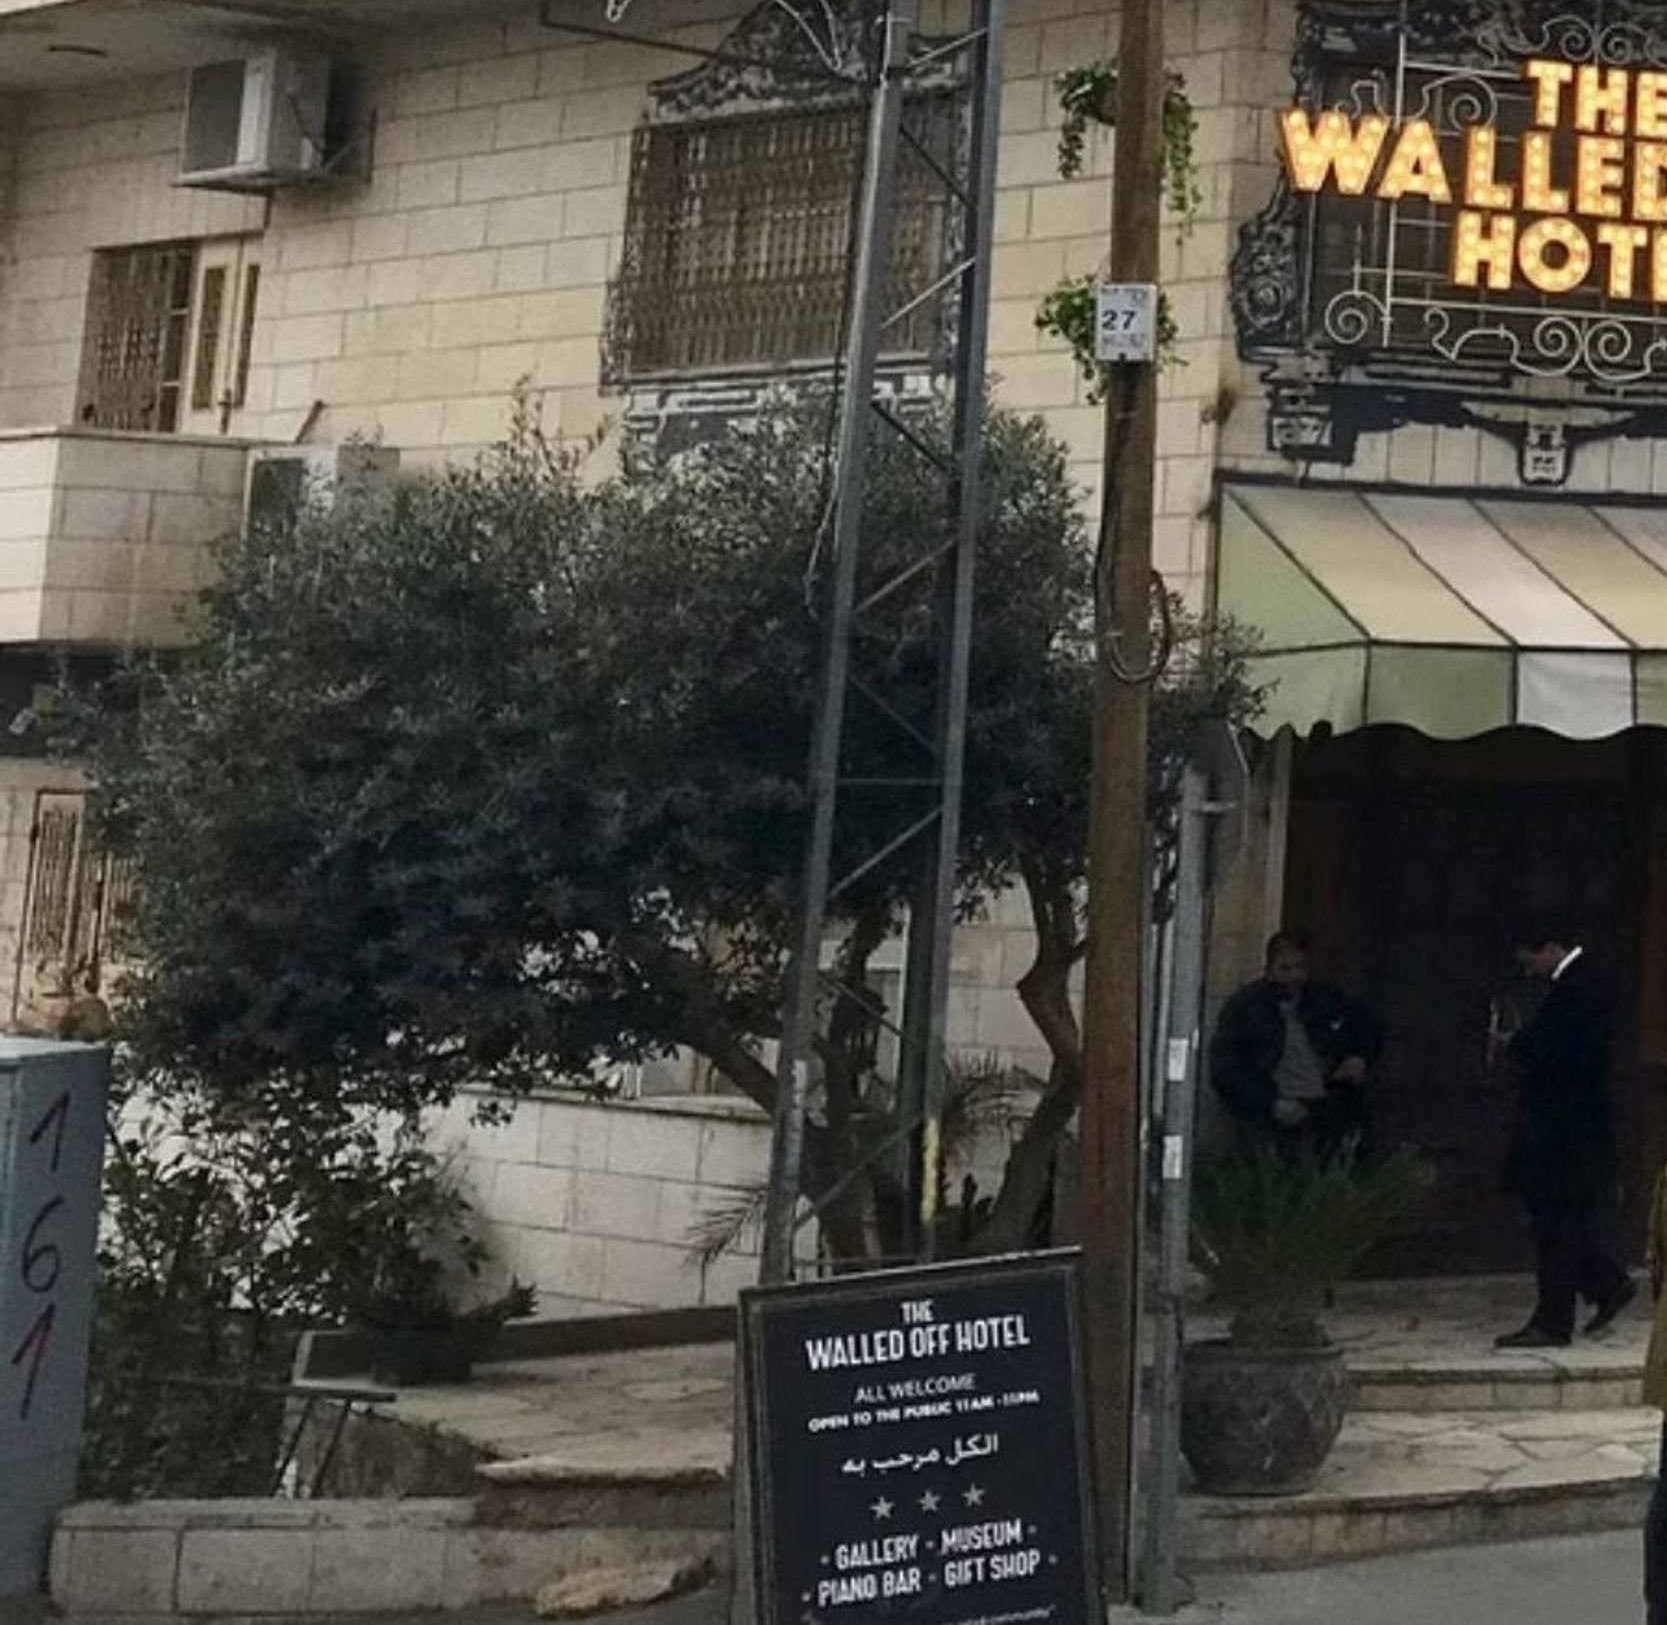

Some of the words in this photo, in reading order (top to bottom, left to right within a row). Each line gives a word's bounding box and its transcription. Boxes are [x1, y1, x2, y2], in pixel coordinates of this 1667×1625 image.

[1101, 309, 1137, 331] 27
[901, 1298, 934, 1325] THE
[805, 1329, 904, 1371] WALLED
[909, 1324, 951, 1359] OFF
[955, 1314, 1031, 1353] HOTEL
[854, 1384, 886, 1404] ALL
[888, 1373, 976, 1400] WELCOME
[808, 1413, 849, 1433] OPEN
[853, 1410, 872, 1426] TO
[875, 1407, 901, 1423] THE
[903, 1401, 952, 1420] PUBLIC
[872, 1448, 941, 1474] مرحب
[945, 1433, 999, 1466] الكل
[835, 1533, 920, 1571] GALLERY
[940, 1517, 1022, 1555] MUSEUM
[817, 1573, 878, 1607] PIANO
[882, 1566, 922, 1599] BAR
[944, 1557, 985, 1588] GIFT
[989, 1548, 1042, 1581] SHOP
